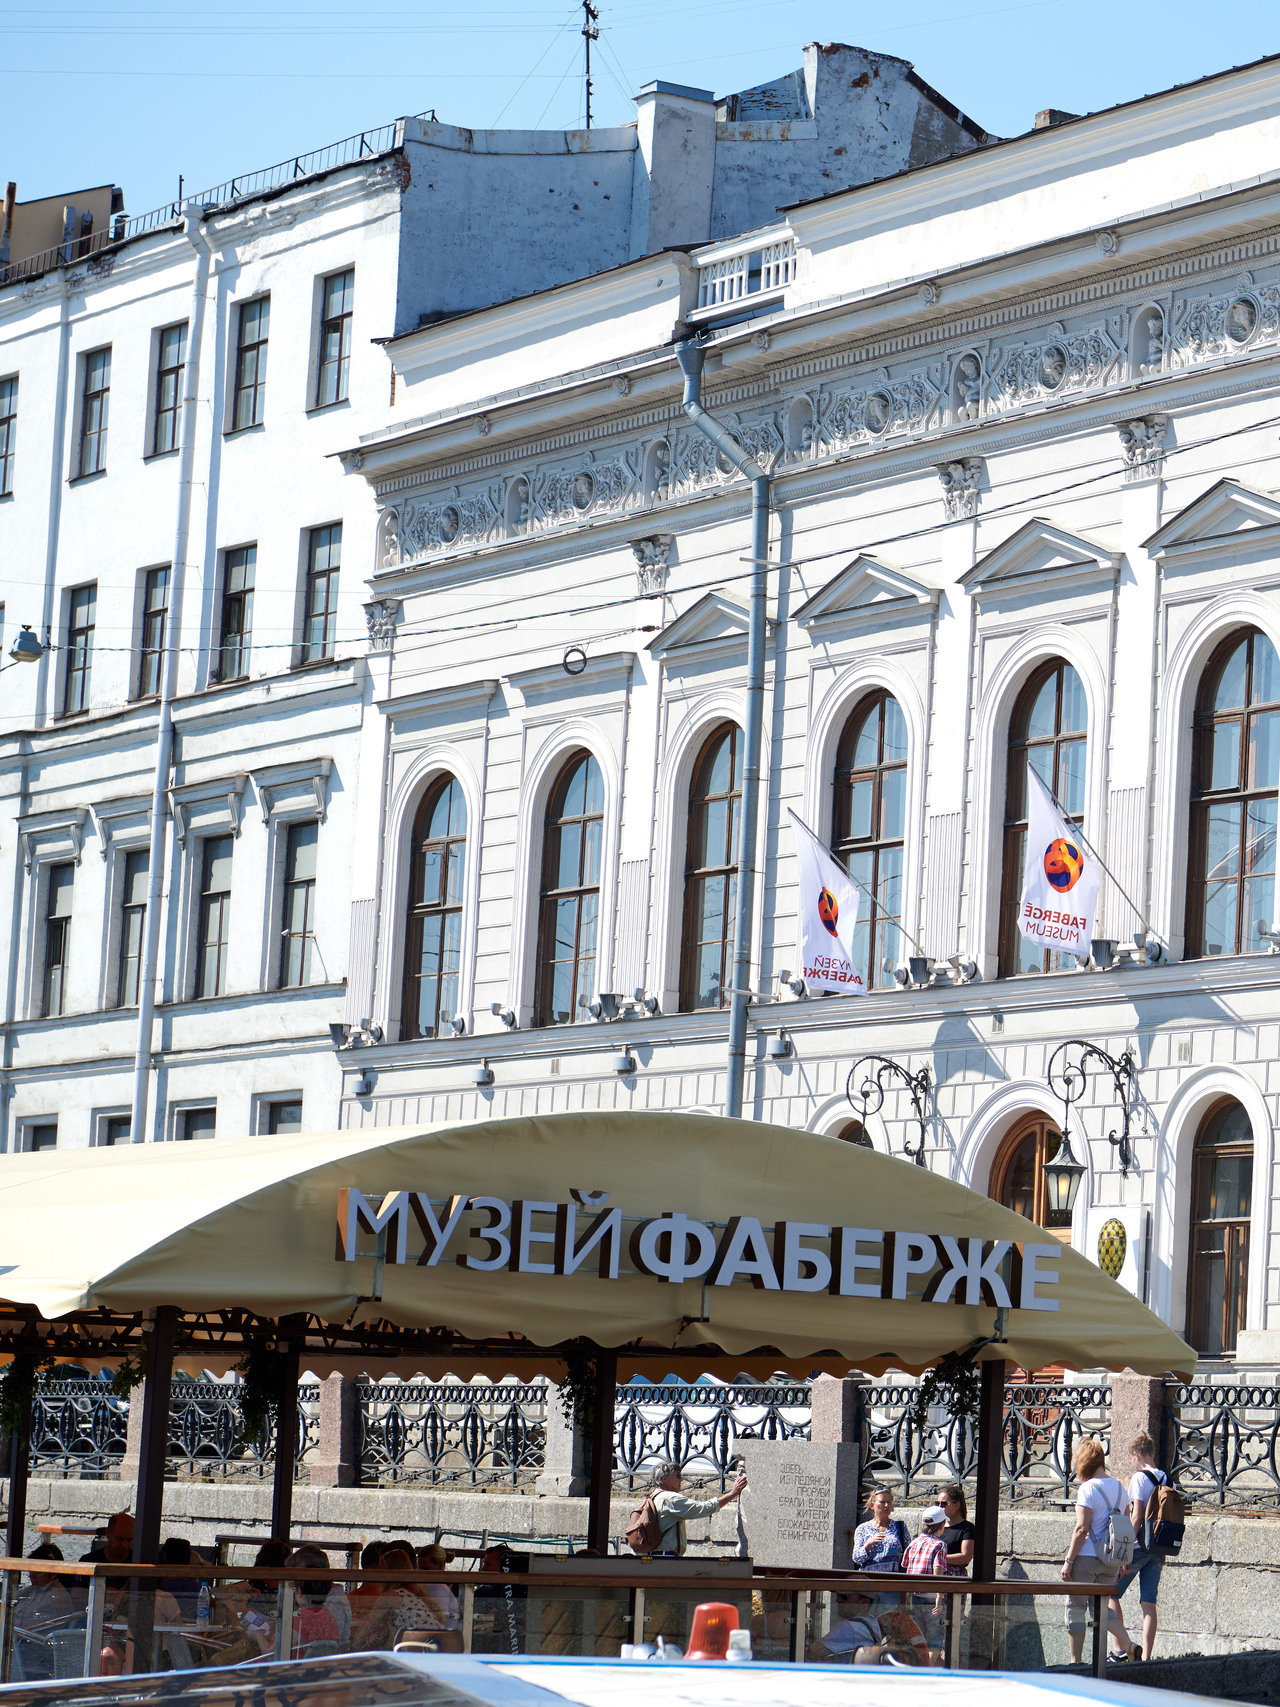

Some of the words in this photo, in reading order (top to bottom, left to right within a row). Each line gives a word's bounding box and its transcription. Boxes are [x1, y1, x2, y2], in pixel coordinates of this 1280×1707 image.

[336, 1188, 622, 1279] МУЗЕЙ
[631, 1211, 1062, 1311] ФАБЕРЖЕ
[780, 1463, 804, 1474] ЗДЕСЬ
[779, 1475, 791, 1485] ИЗ
[794, 1475, 831, 1486] ЛЕДЯНОЙ
[796, 1486, 831, 1497] ПРОРУБИ
[778, 1496, 805, 1508] БРАЛИ
[808, 1498, 830, 1509] ВОДУ
[796, 1509, 830, 1520] ЖИТЕЛИ
[777, 1518, 830, 1531] БЛОКАДНОГО
[777, 1530, 829, 1542] ЛЕНИНГРАДА
[502, 1558, 514, 1610] "ATRA
